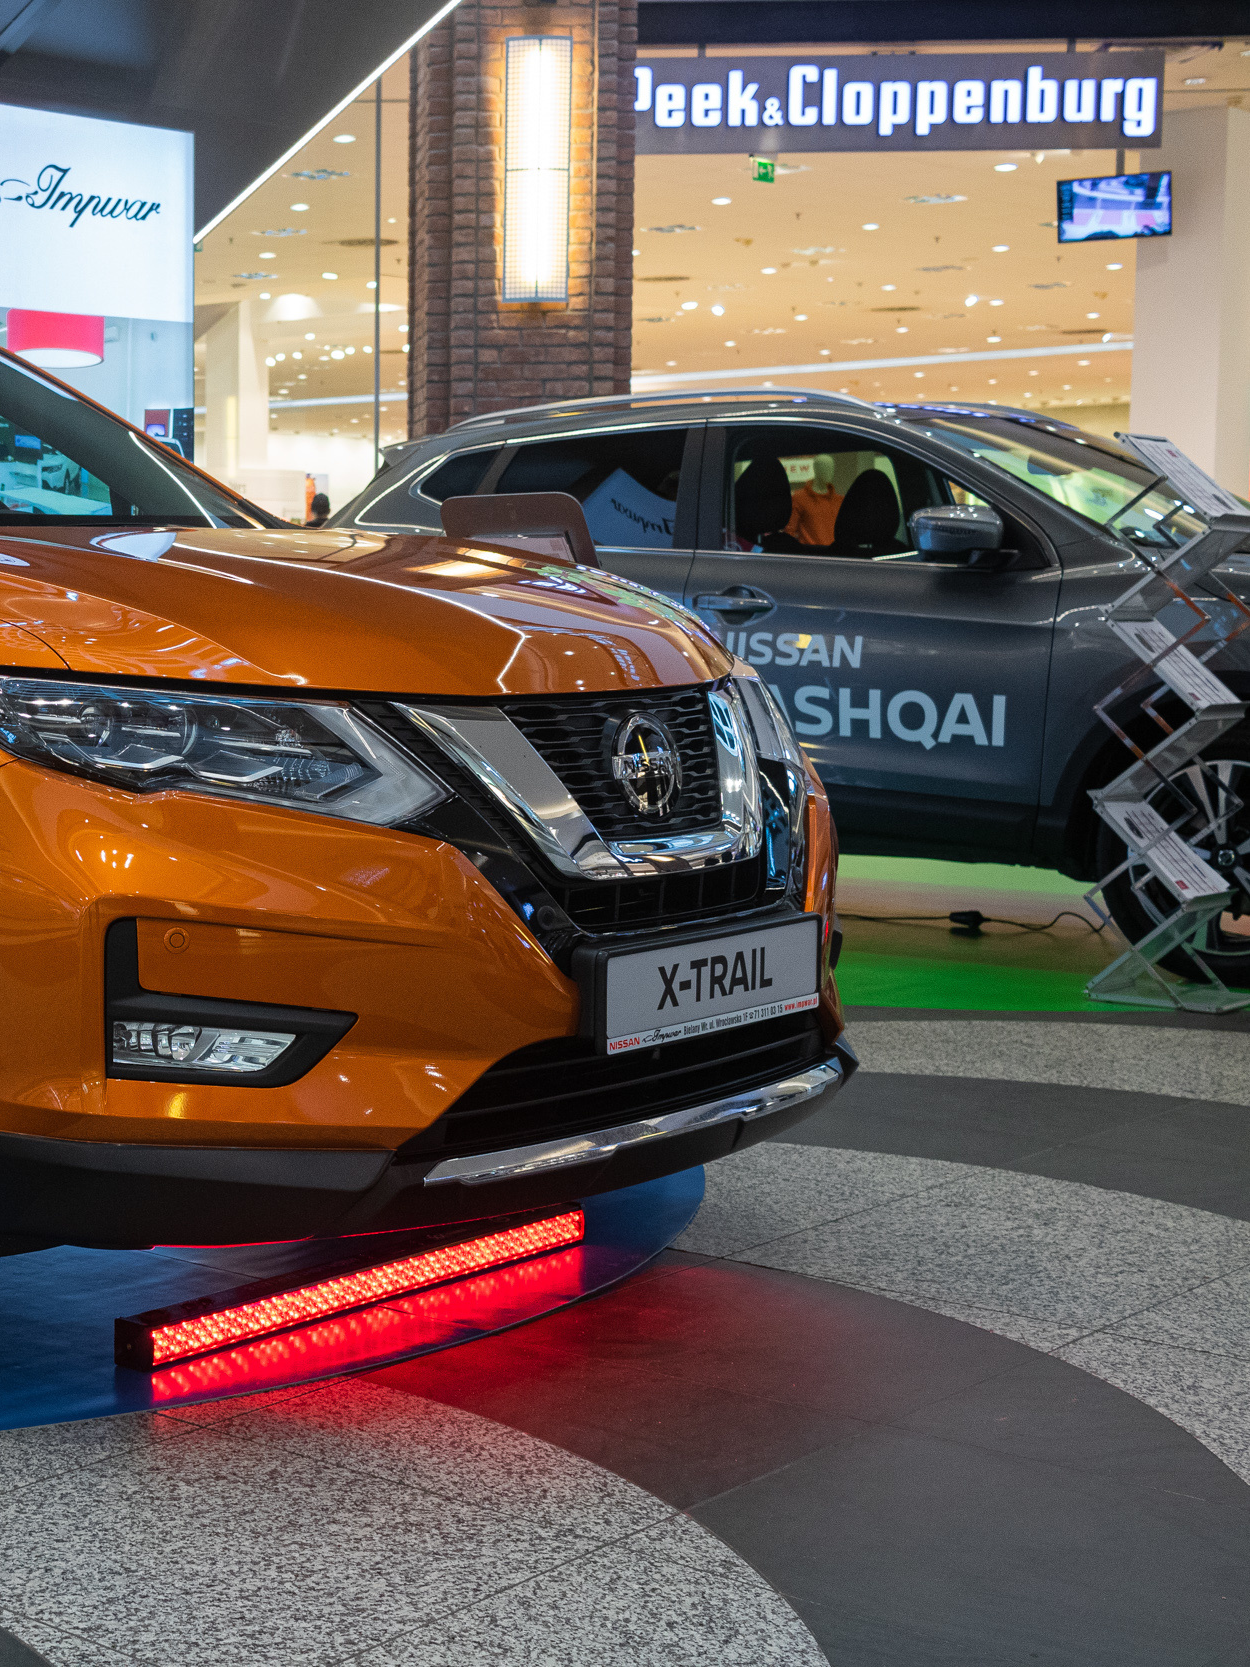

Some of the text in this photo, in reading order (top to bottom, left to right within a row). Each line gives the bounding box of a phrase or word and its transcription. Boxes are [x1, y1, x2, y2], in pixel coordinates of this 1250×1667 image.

[25, 164, 161, 228] Impwar
[657, 946, 773, 1010] X-TRAIL
[609, 1037, 640, 1052] NISSAN
[777, 1003, 783, 1014] 15
